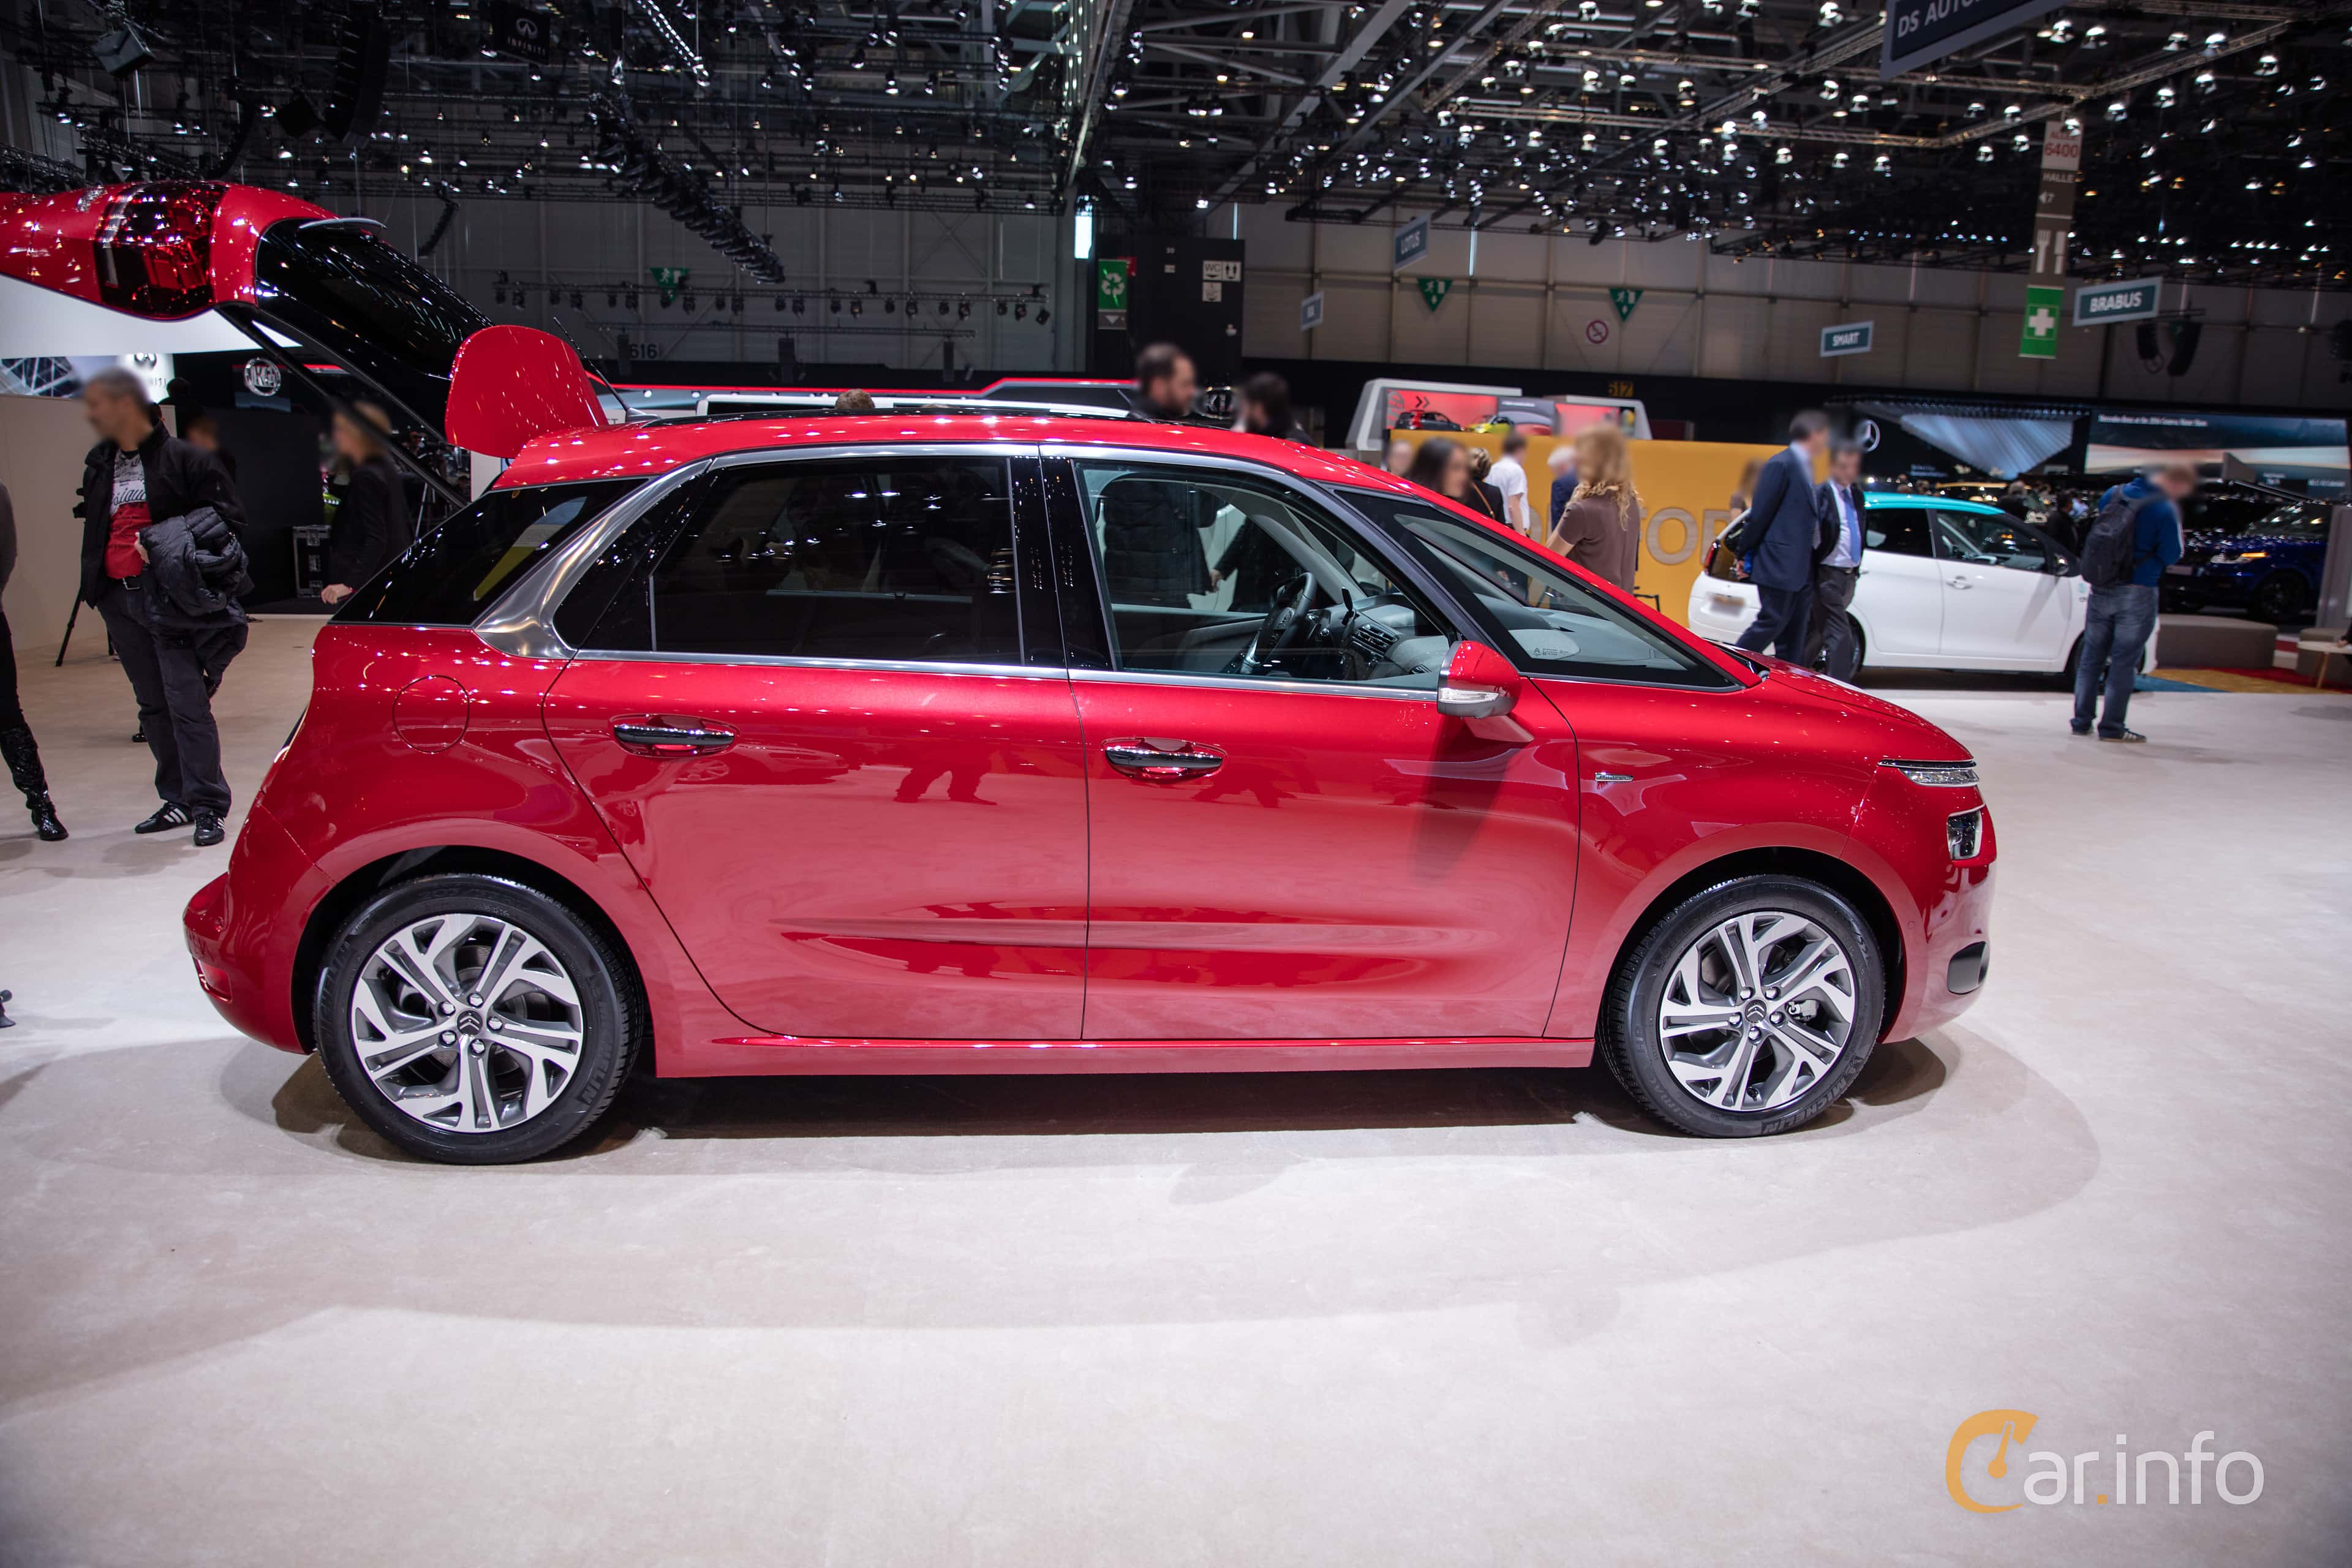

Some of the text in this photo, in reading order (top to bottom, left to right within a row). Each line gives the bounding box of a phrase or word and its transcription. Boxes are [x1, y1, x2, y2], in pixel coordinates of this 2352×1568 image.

[1898, 9, 1921, 38] DS
[508, 37, 546, 56] INFINITI
[2045, 143, 2079, 157] 6400
[2043, 172, 2075, 183] HALLE
[1400, 230, 1420, 255] LOTUS
[1205, 263, 1221, 272] WC
[2090, 292, 2143, 312] BRABUS
[1832, 331, 1860, 347] SMART
[1763, 1076, 1847, 1134] MICHELIN
